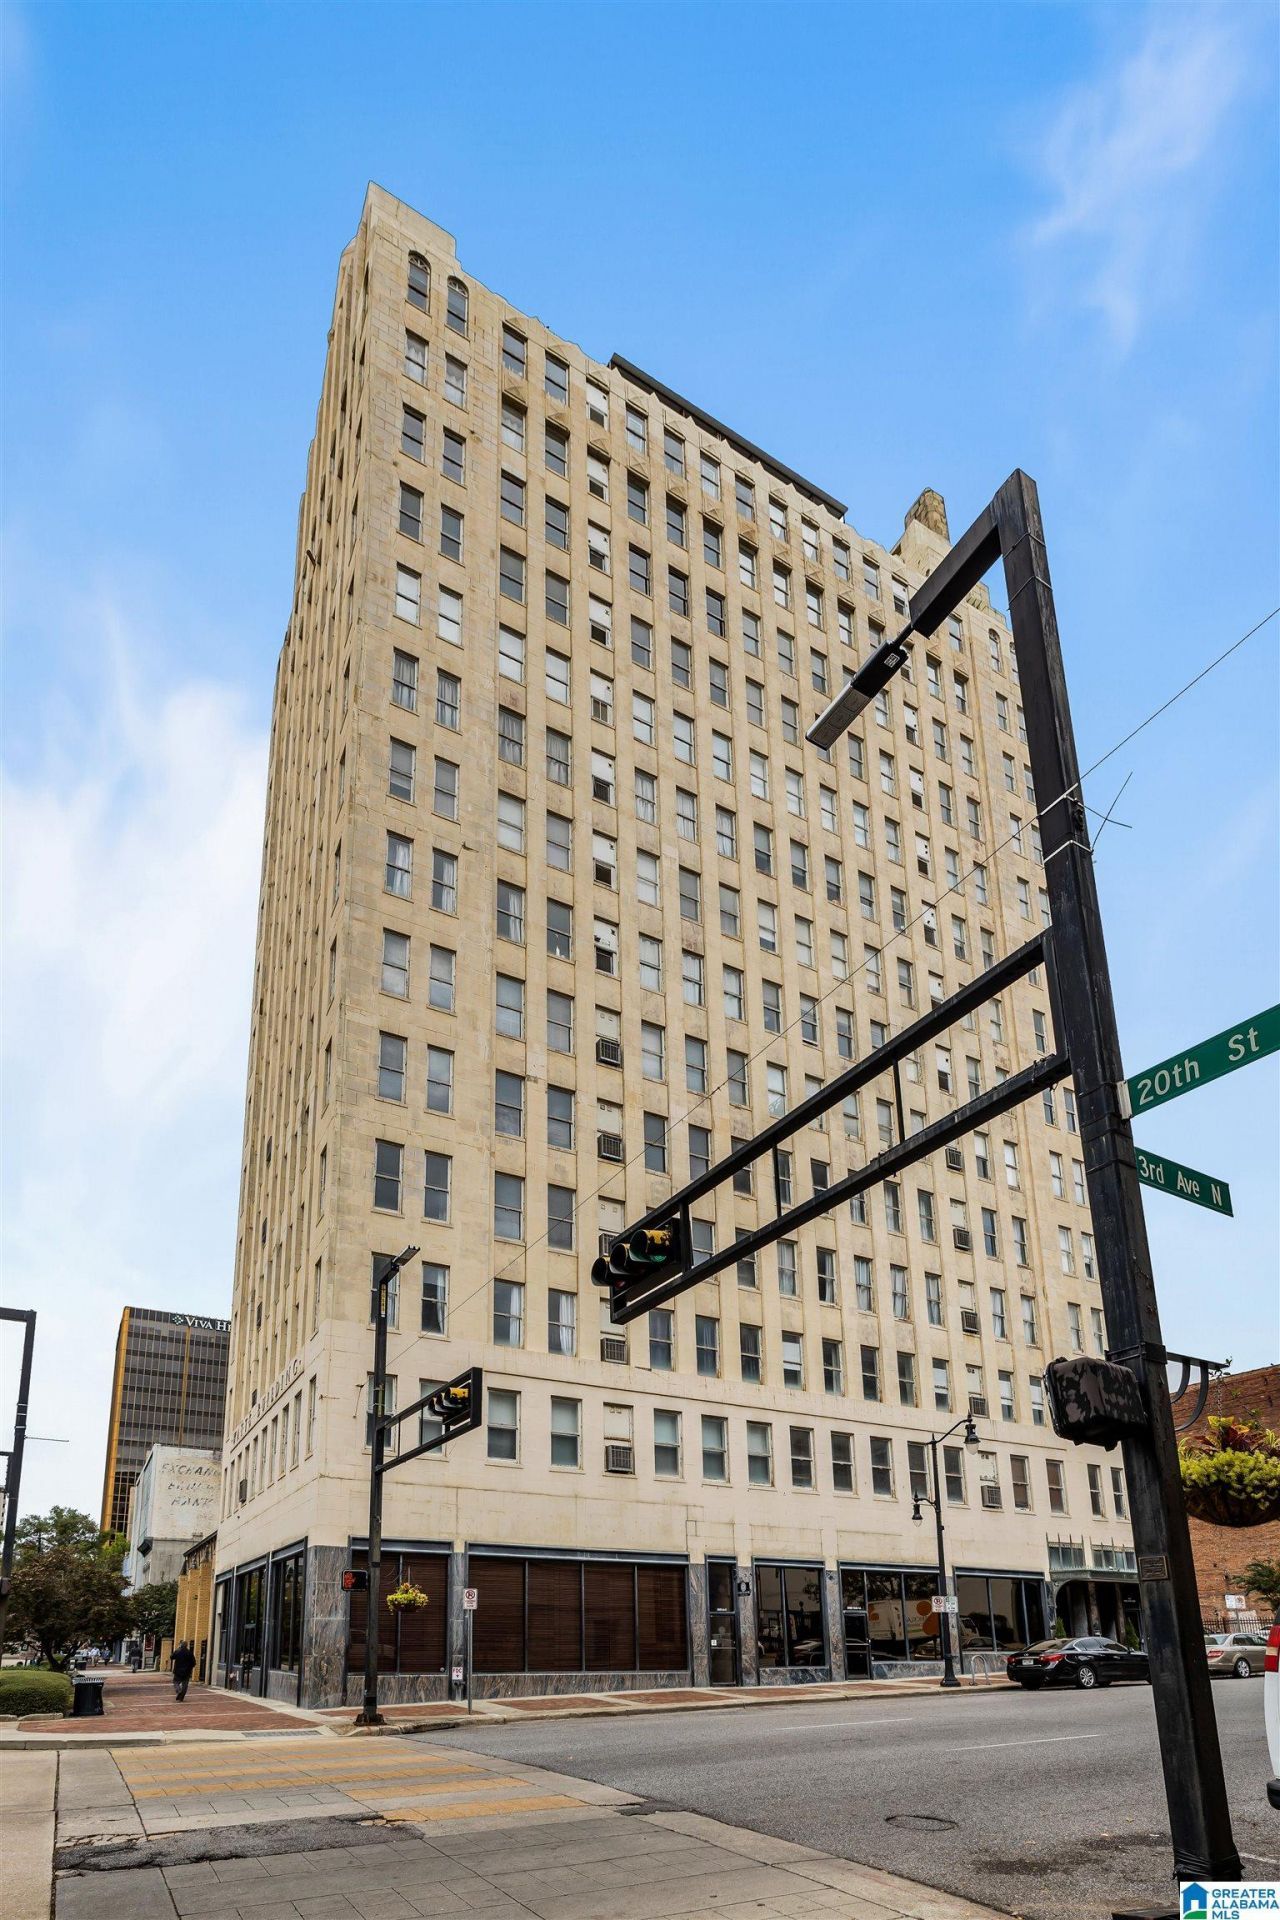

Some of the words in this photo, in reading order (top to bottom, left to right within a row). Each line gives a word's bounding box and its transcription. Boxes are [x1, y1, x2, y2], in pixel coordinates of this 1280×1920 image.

[1137, 1058, 1200, 1105] 20th
[1228, 1027, 1260, 1061] St
[1138, 1155, 1164, 1185] 3rd
[1177, 1170, 1200, 1197] Ave
[1211, 1183, 1222, 1206] N
[185, 1316, 213, 1329] VIVA
